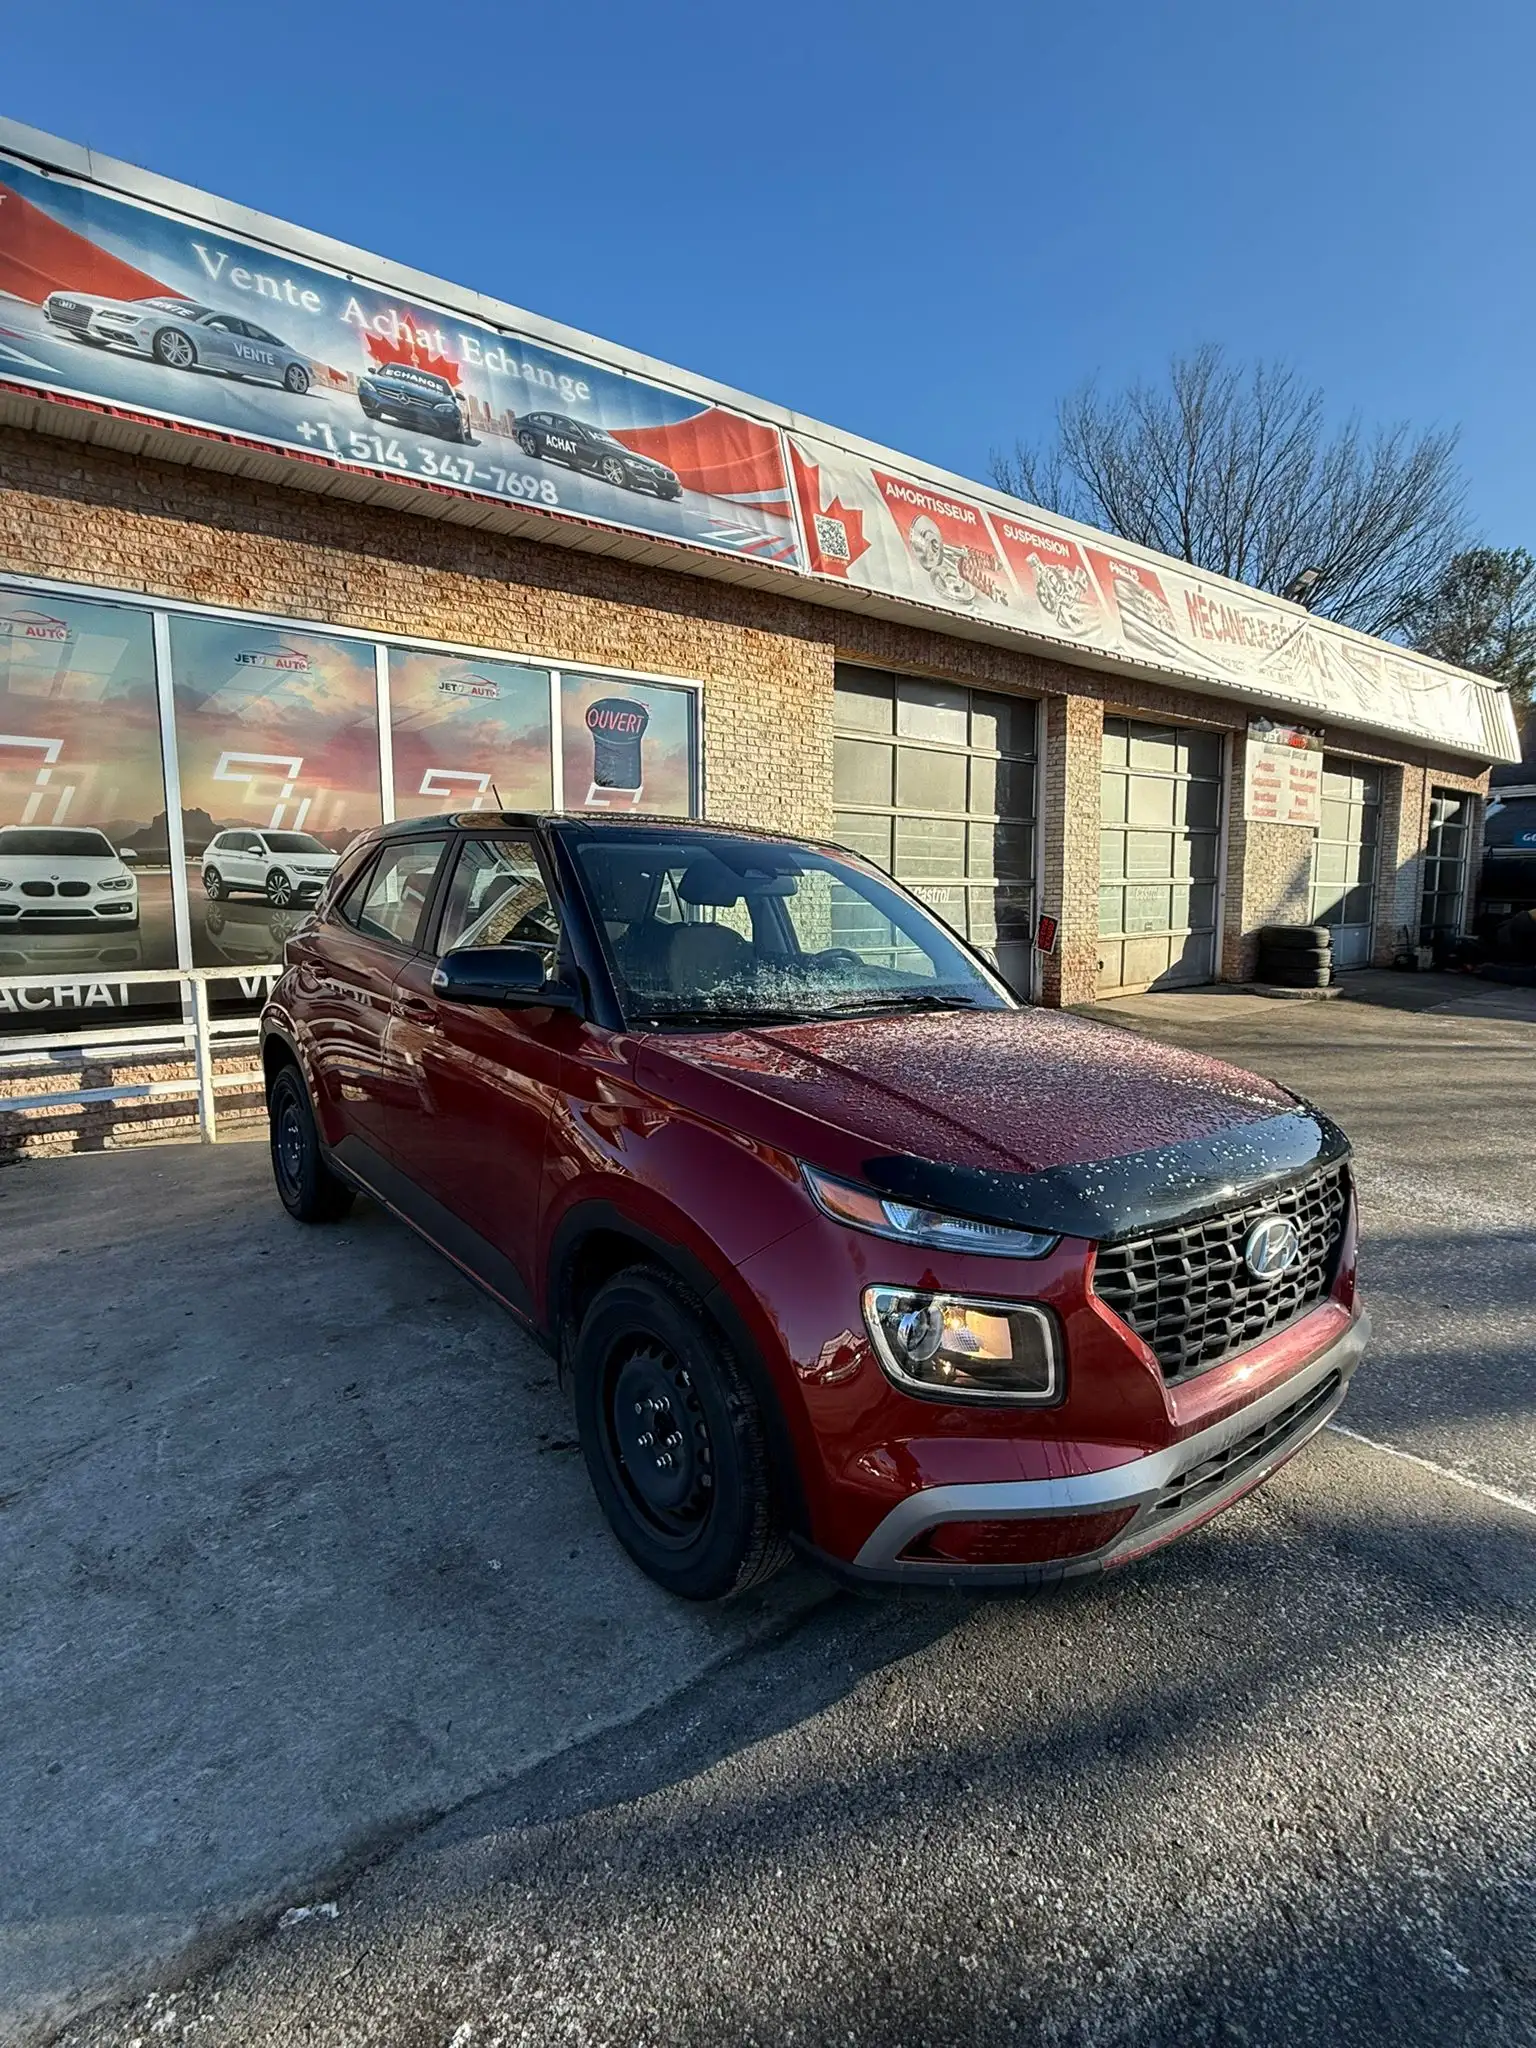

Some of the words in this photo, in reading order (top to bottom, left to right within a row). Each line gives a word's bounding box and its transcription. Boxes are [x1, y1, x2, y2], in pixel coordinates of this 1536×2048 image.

[191, 242, 322, 314] Vente
[340, 297, 448, 354] Achat
[458, 334, 591, 402] Echange
[233, 342, 275, 366] VENTE
[385, 368, 444, 392] ECHANGE
[546, 434, 577, 455] ACHAT
[350, 431, 408, 468] 514
[418, 447, 559, 505] 347-7698
[885, 480, 977, 526] AMORTISSEUR
[1003, 523, 1069, 558] SUSPENSION
[235, 653, 257, 664] JET
[439, 682, 457, 692] JET
[587, 708, 645, 733] OUVERT
[913, 886, 951, 903] Castrol
